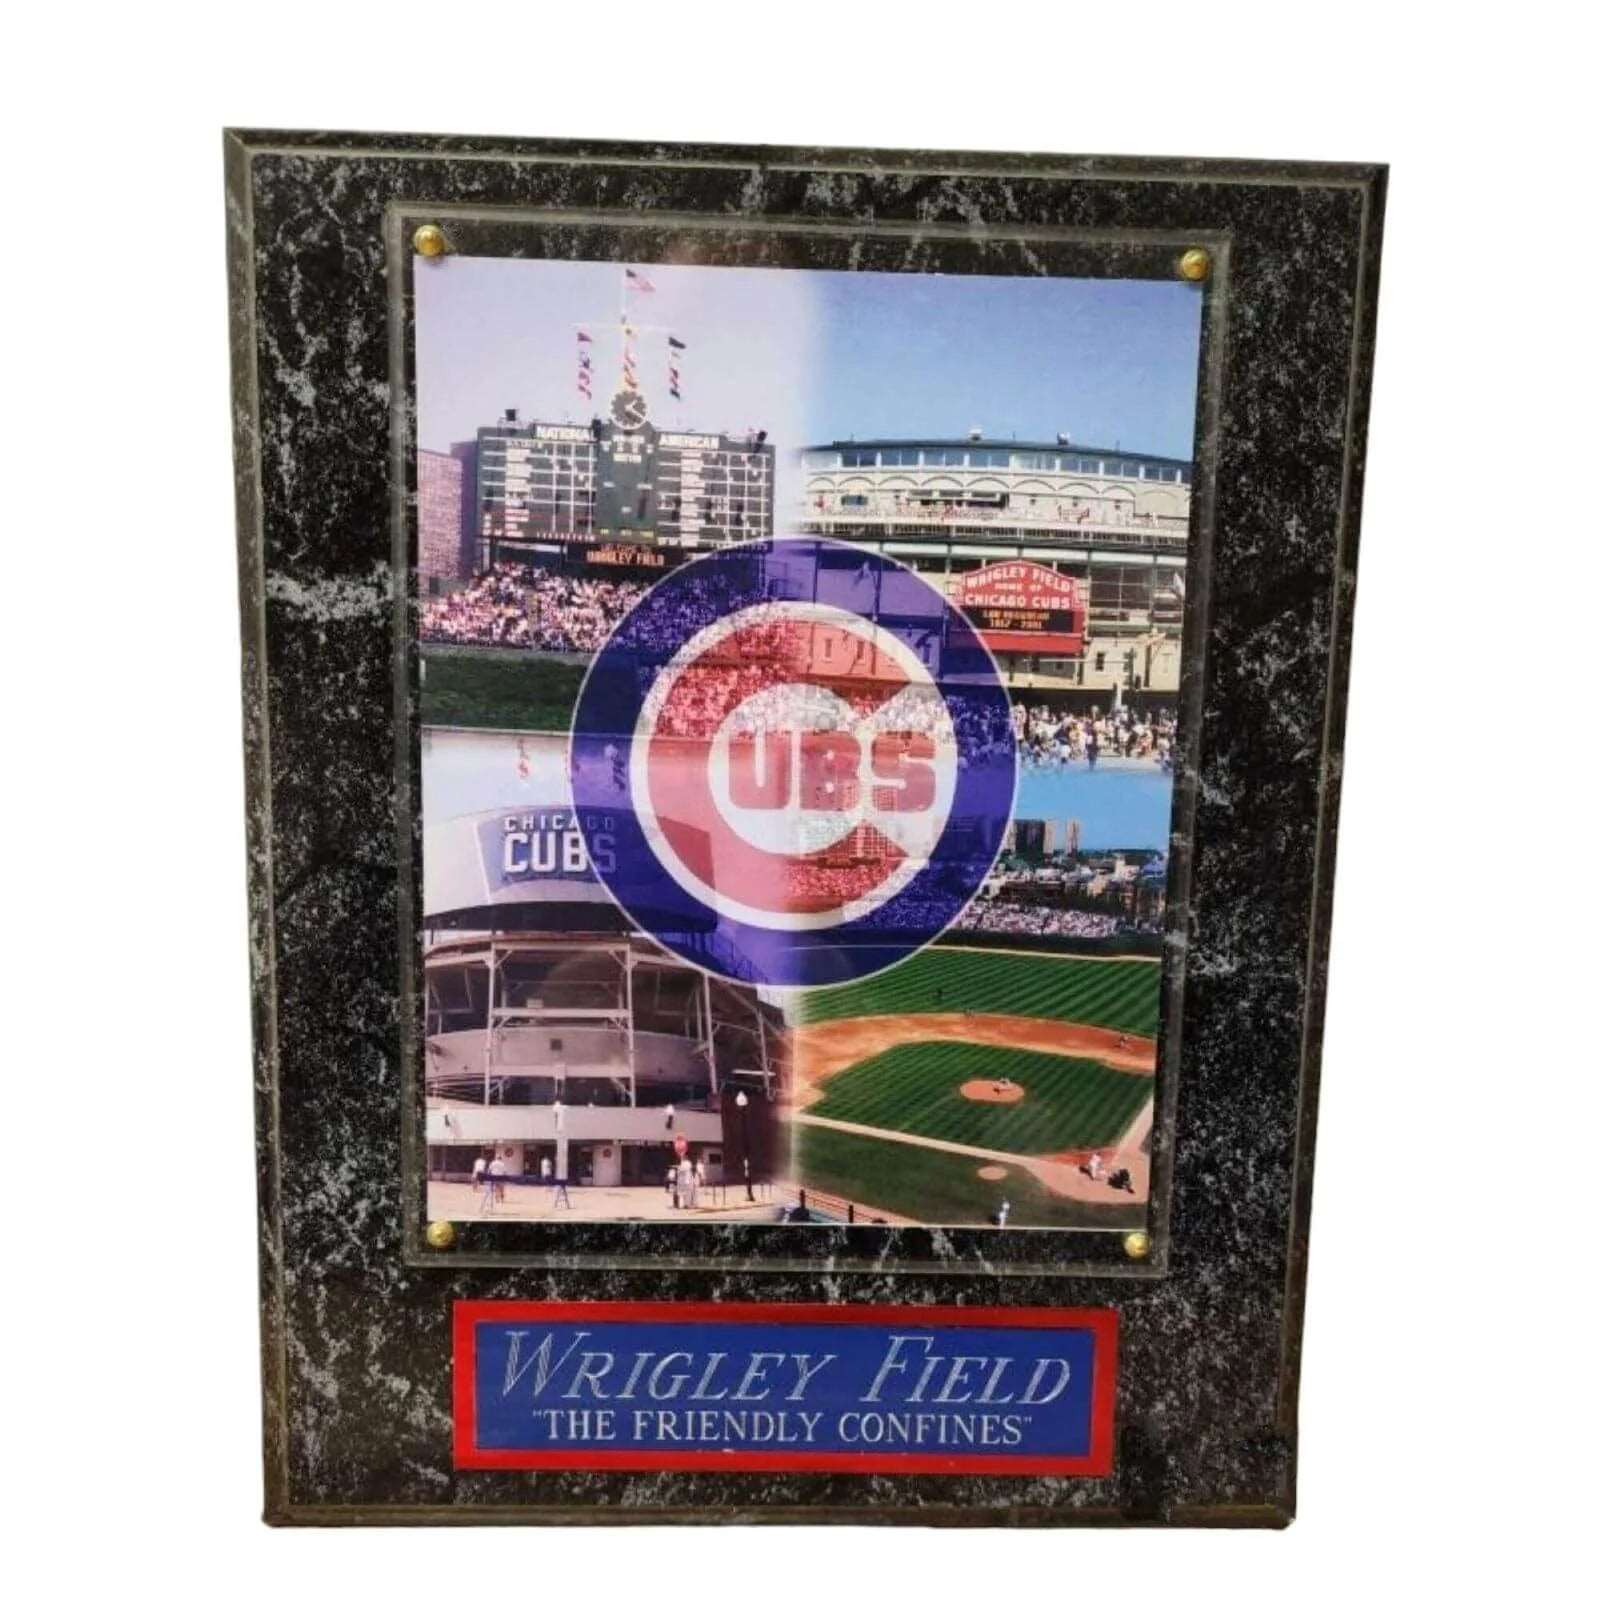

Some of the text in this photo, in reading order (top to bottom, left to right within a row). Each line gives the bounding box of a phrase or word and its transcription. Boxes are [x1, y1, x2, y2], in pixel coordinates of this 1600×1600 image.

[966, 566, 1071, 592] WRIGLEY FIELD
[965, 594, 1071, 609] CHICAGO CUBS
[504, 815, 614, 832] CHICAGO
[504, 831, 616, 873] CUBS
[532, 1409, 1032, 1445] "THE FRIENDLY CONFINES"
